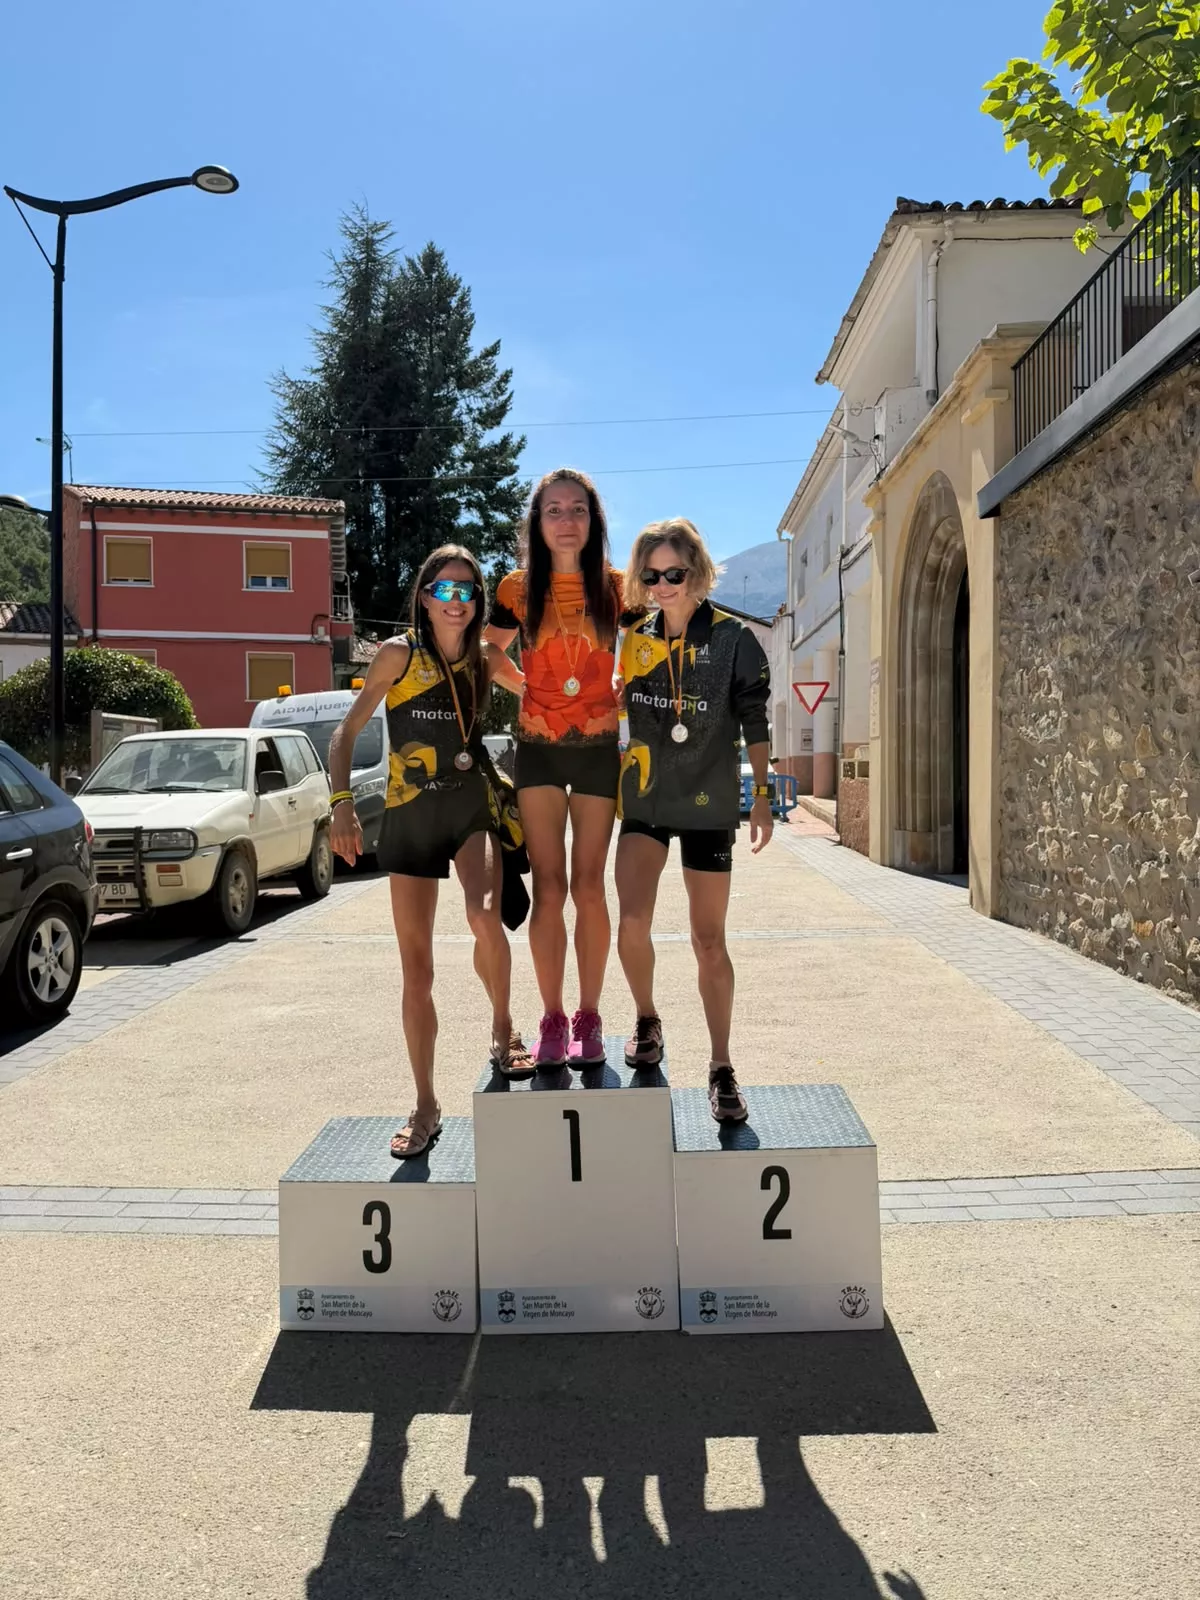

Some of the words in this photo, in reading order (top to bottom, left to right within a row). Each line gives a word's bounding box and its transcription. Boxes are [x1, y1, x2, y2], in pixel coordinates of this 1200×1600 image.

[563, 1110, 582, 1181] 1
[760, 1165, 792, 1240] 2
[362, 1200, 392, 1273] 3
[434, 1289, 459, 1299] TRAIL
[637, 1286, 662, 1296] TRAIL
[841, 1285, 866, 1295] TRAIL
[764, 1300, 770, 1308] la
[321, 1309, 339, 1317] Virgen
[349, 1309, 373, 1318] Moncayo
[522, 1310, 541, 1319] Virgen
[550, 1310, 575, 1318] Moncayo
[724, 1310, 743, 1319] Virgen
[752, 1309, 778, 1318] Moncayo
